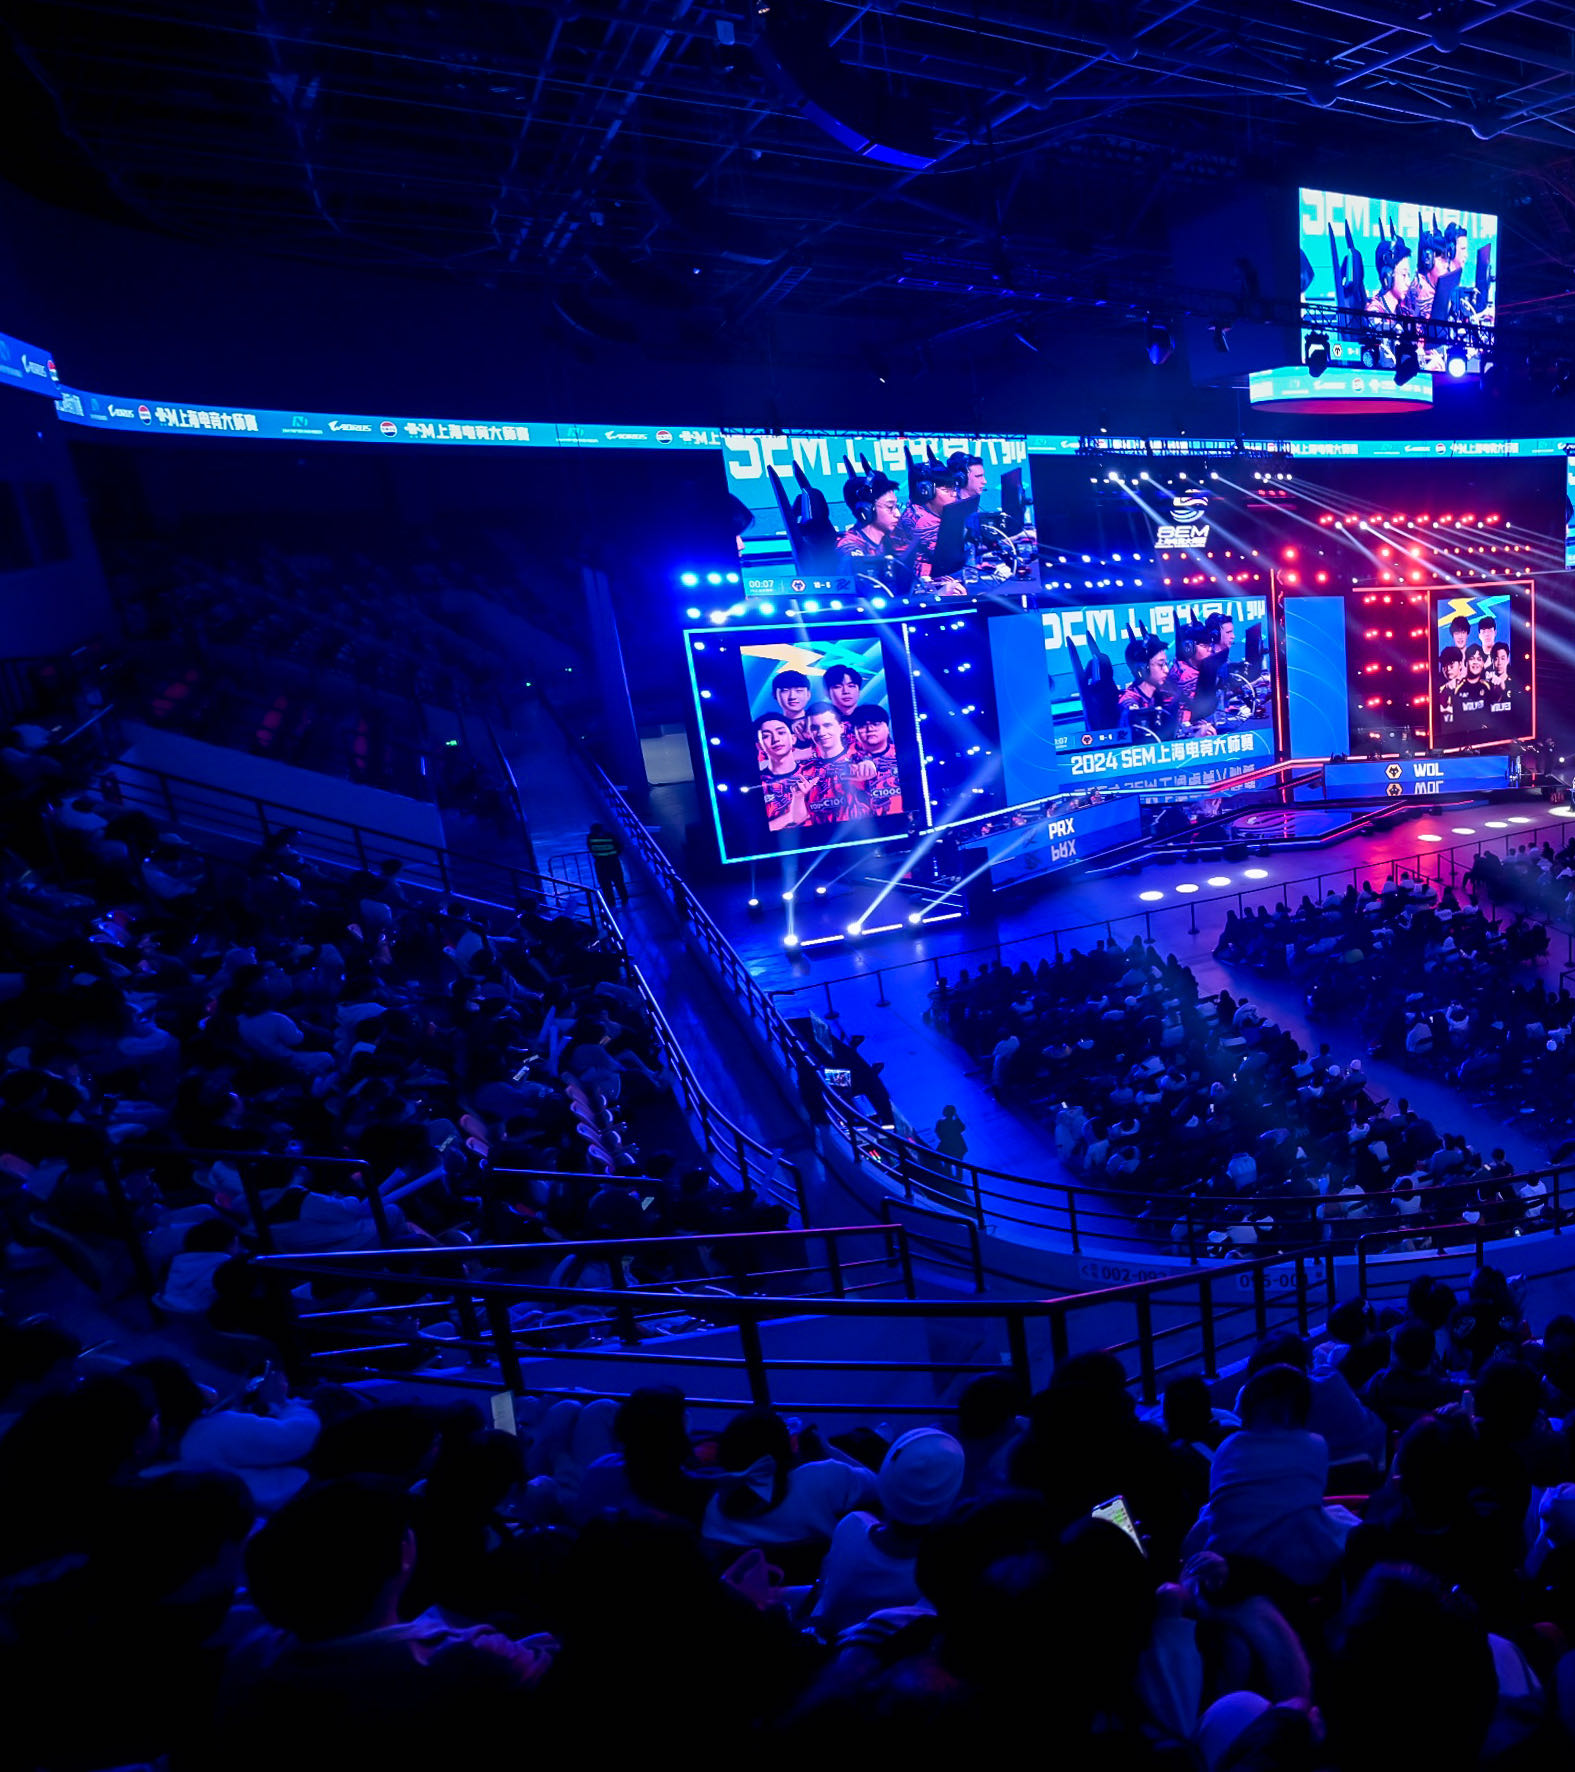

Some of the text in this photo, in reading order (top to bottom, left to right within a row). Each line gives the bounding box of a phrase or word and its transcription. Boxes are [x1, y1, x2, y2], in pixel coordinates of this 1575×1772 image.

[1071, 734, 1254, 775] 2024 SEM上海电竞大师赛
[1413, 762, 1444, 778] WOL
[1048, 817, 1075, 840] PRX
